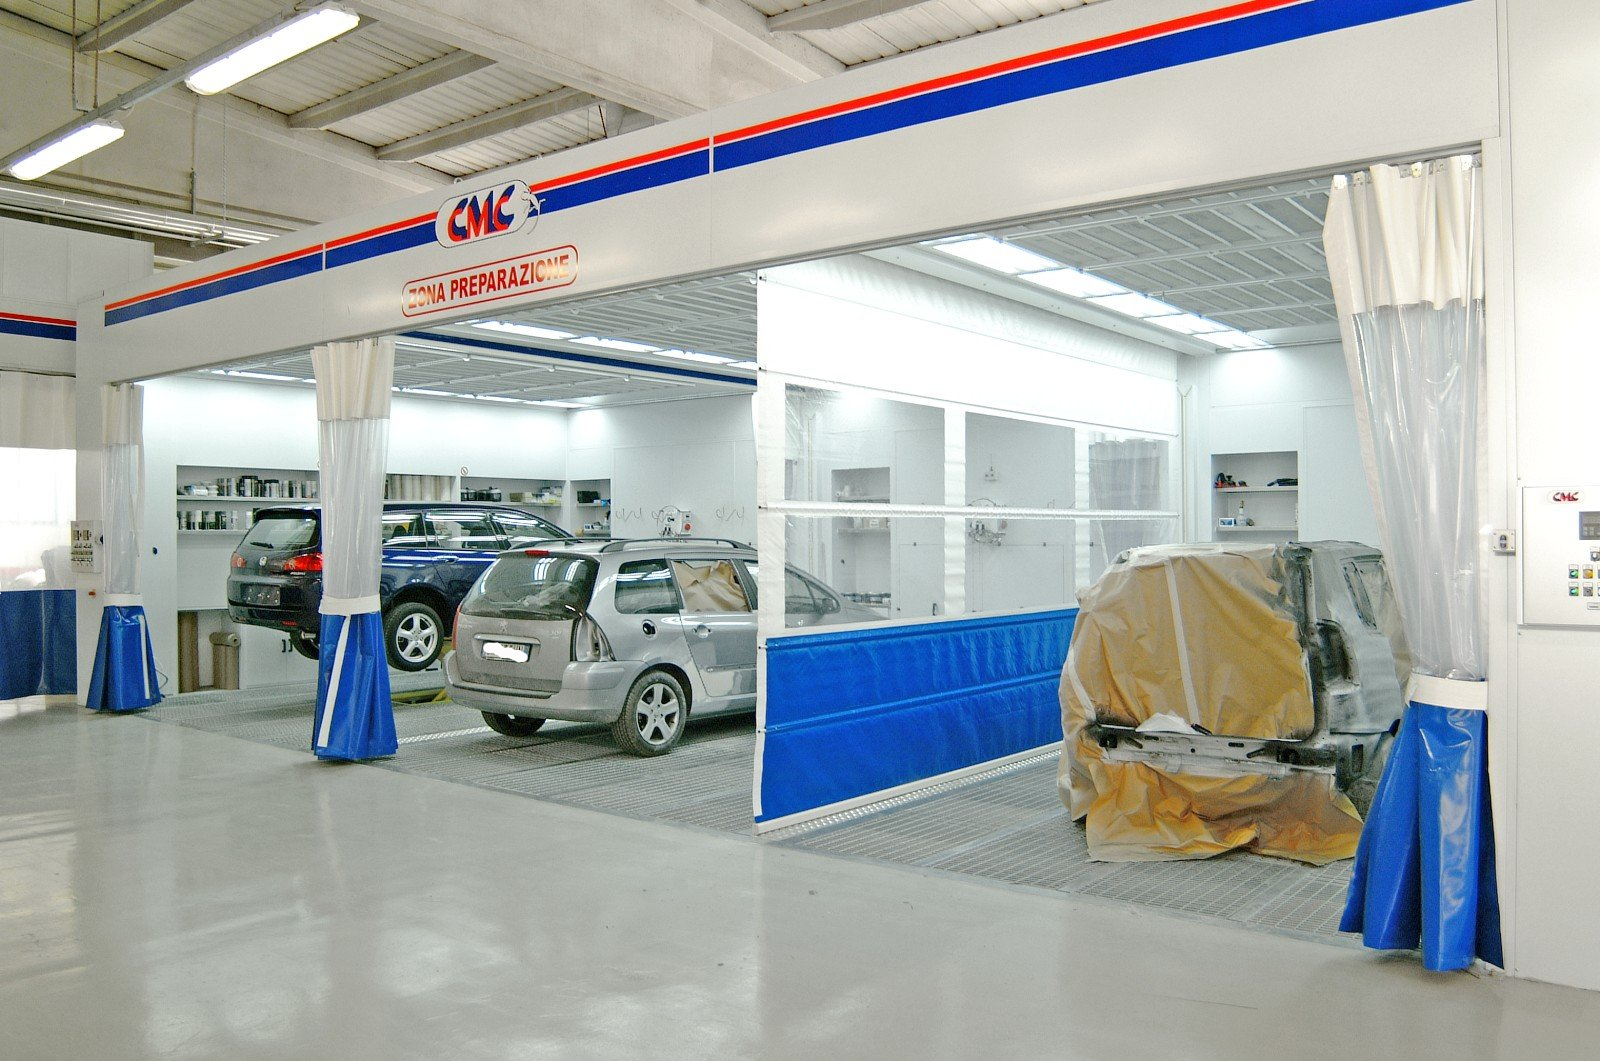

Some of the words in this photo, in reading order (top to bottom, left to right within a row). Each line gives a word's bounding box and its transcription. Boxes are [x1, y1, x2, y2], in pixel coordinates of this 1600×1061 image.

[448, 184, 515, 242] CMC
[408, 282, 445, 309] ZONA
[450, 254, 569, 300] PREPARAZIONE
[1553, 491, 1579, 502] CMC
